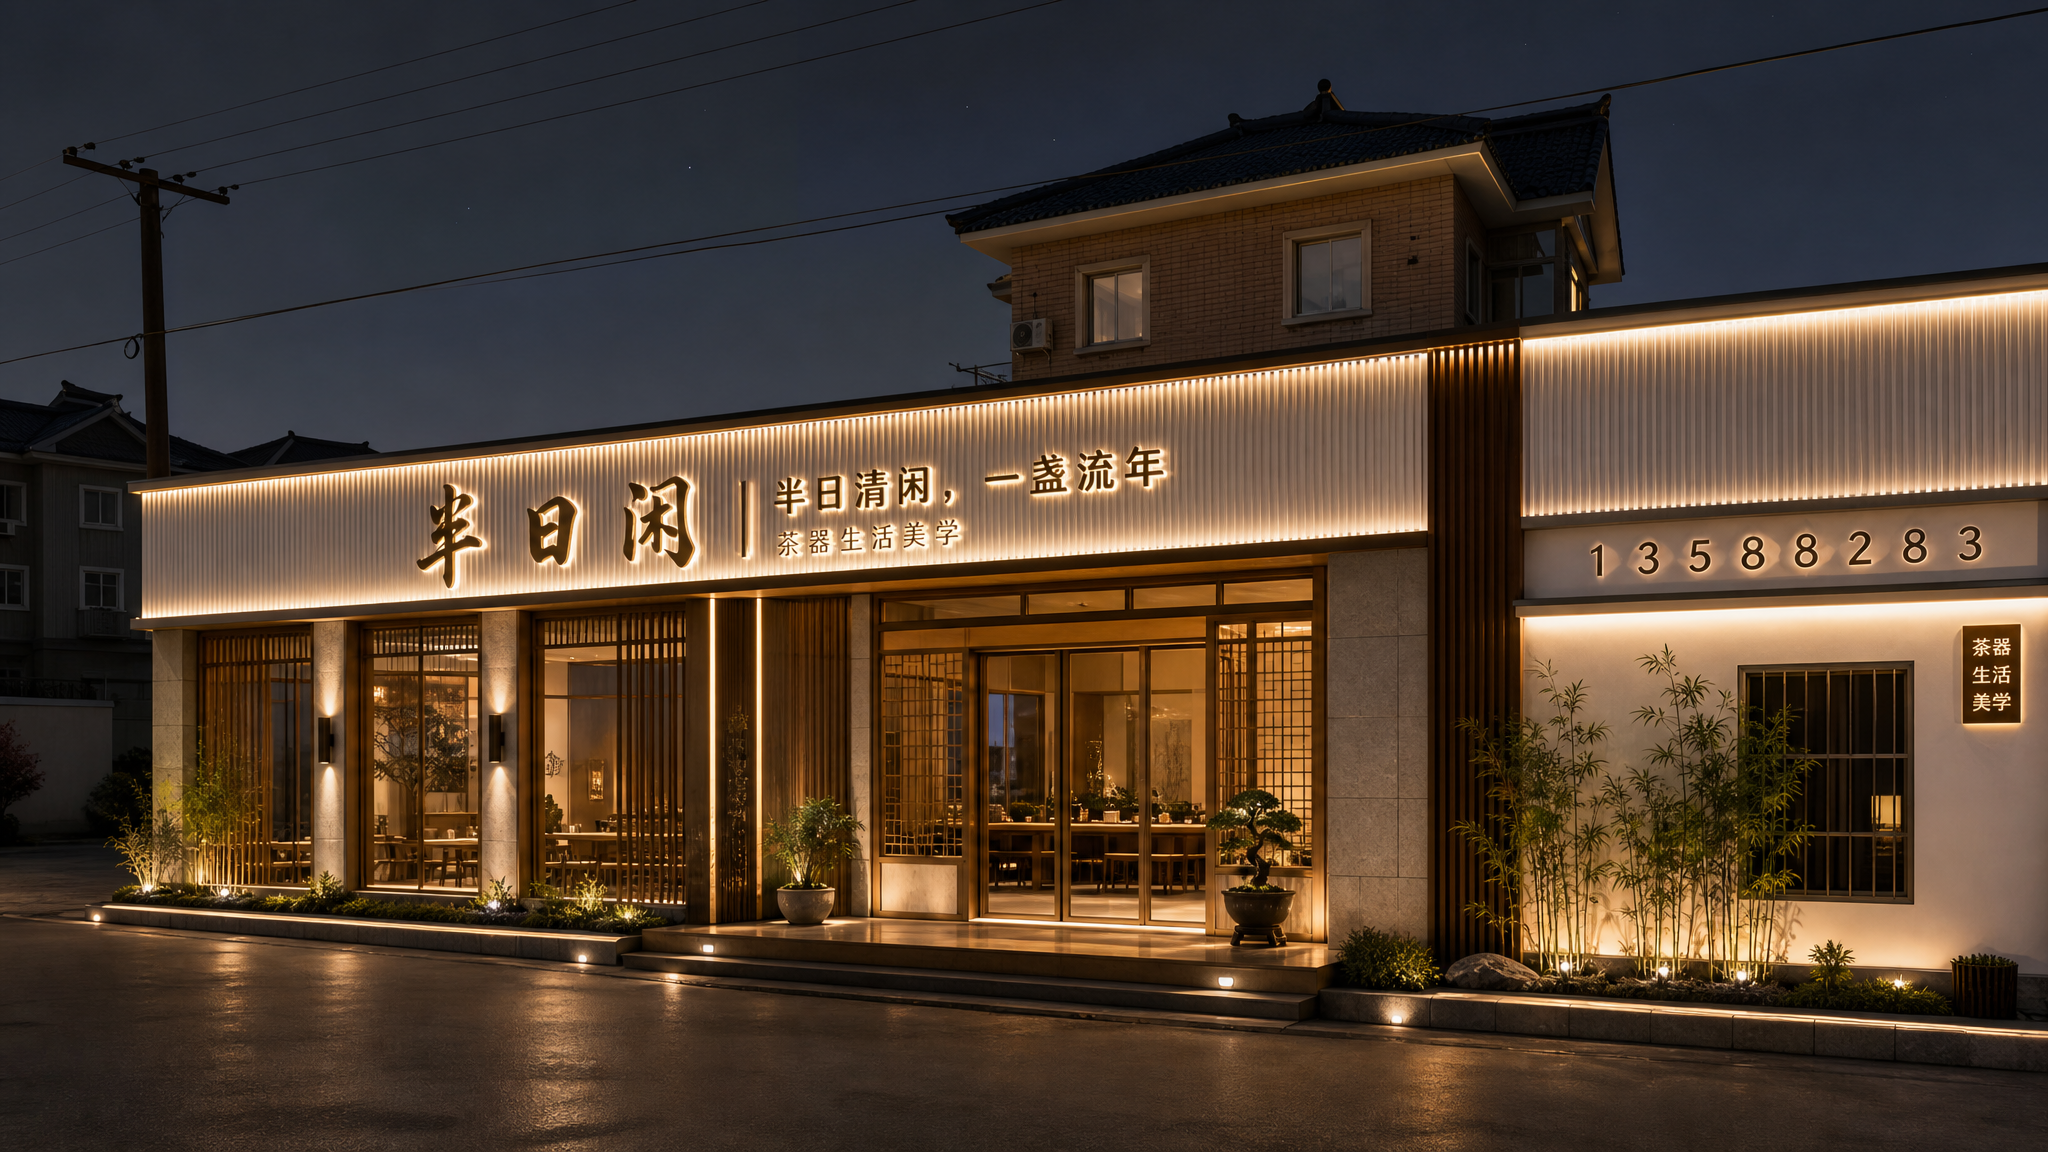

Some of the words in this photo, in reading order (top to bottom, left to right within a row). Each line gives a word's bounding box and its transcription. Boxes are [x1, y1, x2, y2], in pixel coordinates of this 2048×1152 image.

[774, 446, 1164, 514] 半日清闲，一盏流年
[416, 476, 695, 589] 半日闲
[777, 519, 960, 557] 茶器生活美学
[1972, 637, 2011, 656] 茶器
[1972, 665, 2011, 684] 生活
[1972, 692, 2011, 712] 美学
